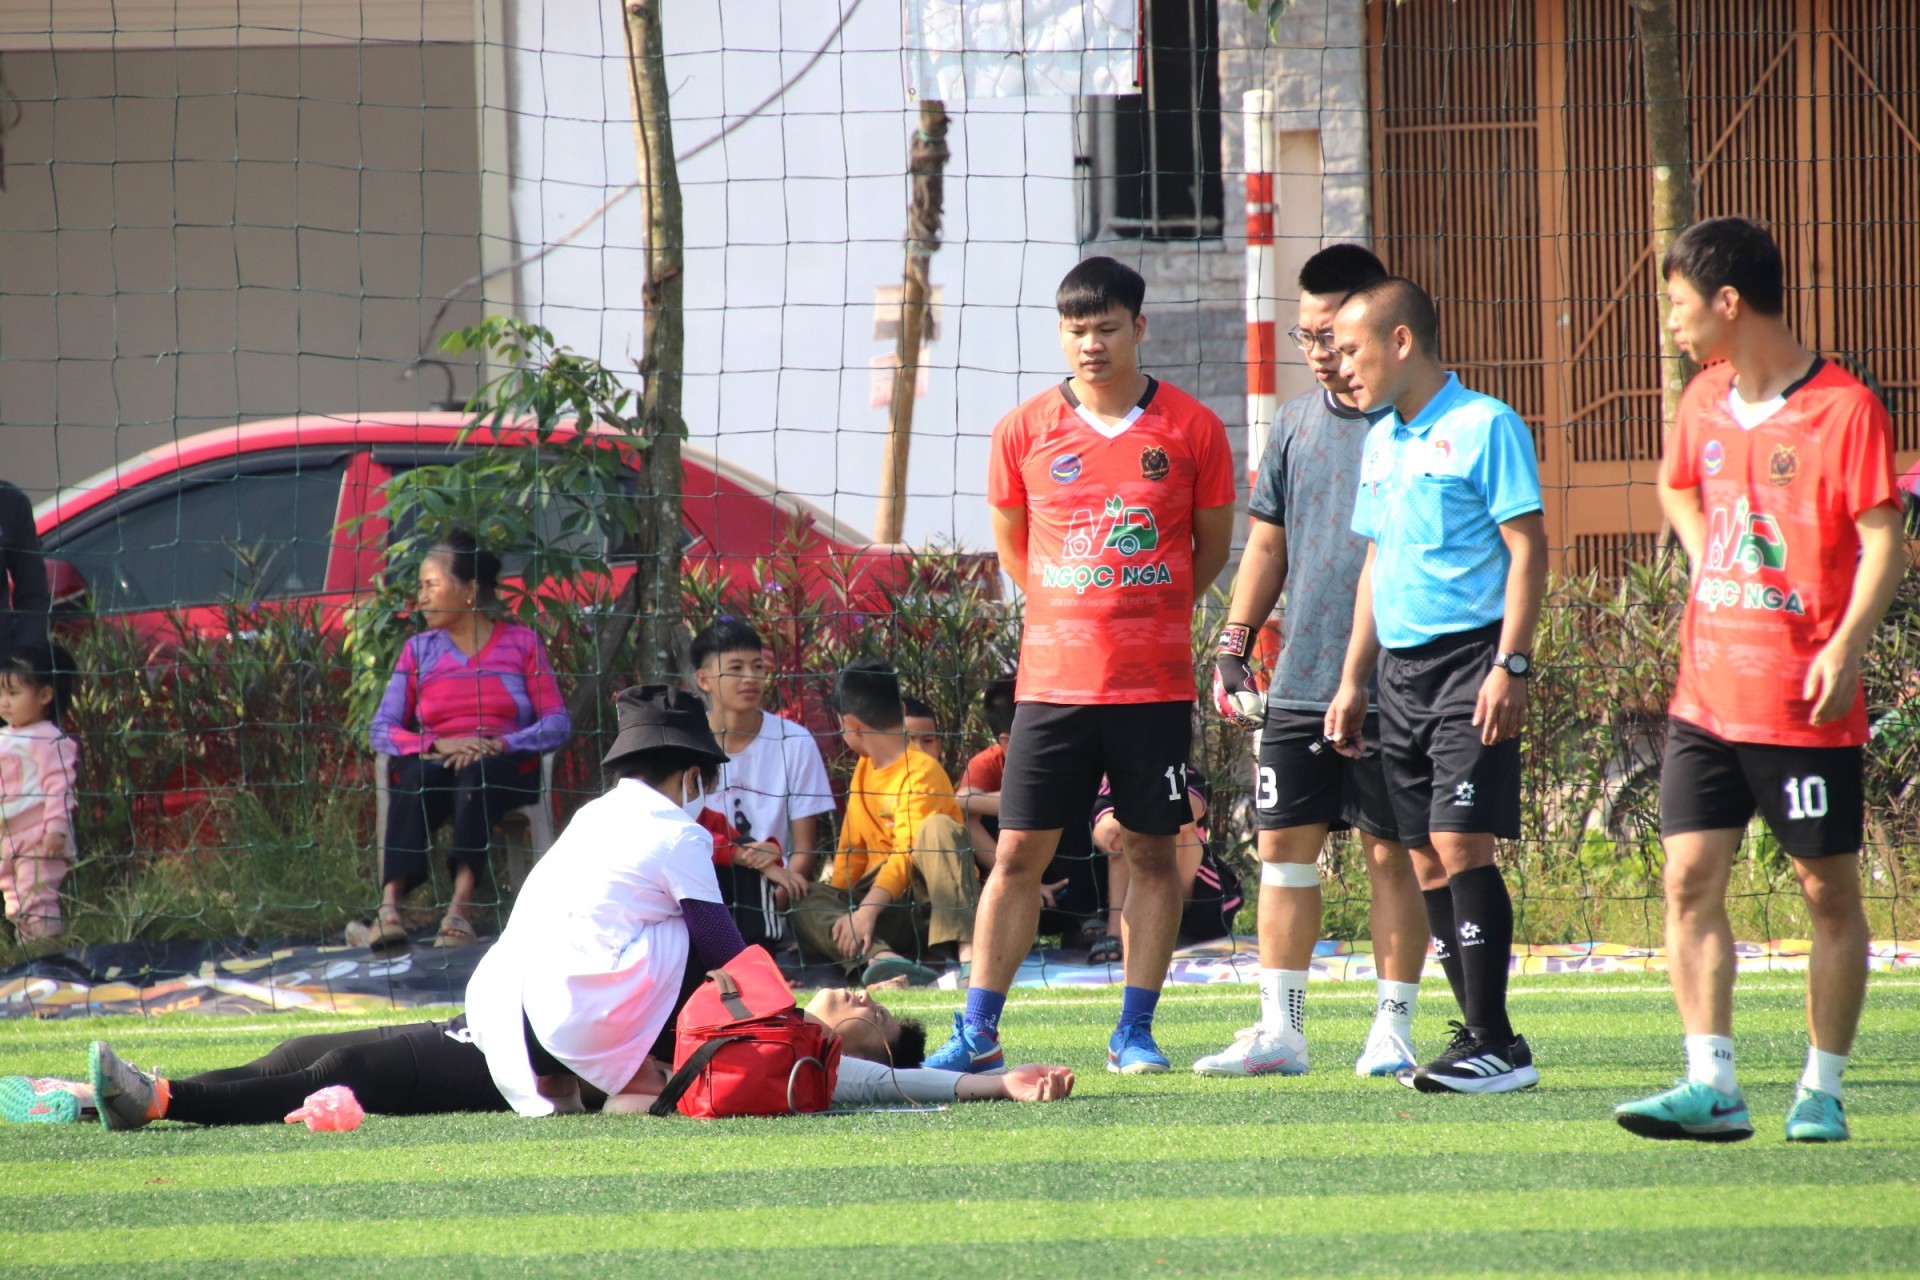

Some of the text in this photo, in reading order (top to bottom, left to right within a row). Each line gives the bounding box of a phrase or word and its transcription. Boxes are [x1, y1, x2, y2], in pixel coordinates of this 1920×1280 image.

[1042, 562, 1172, 594] NGỌC NGA
[1744, 584, 1805, 615] NGA
[1255, 766, 1279, 809] 3
[1785, 775, 1829, 820] 10
